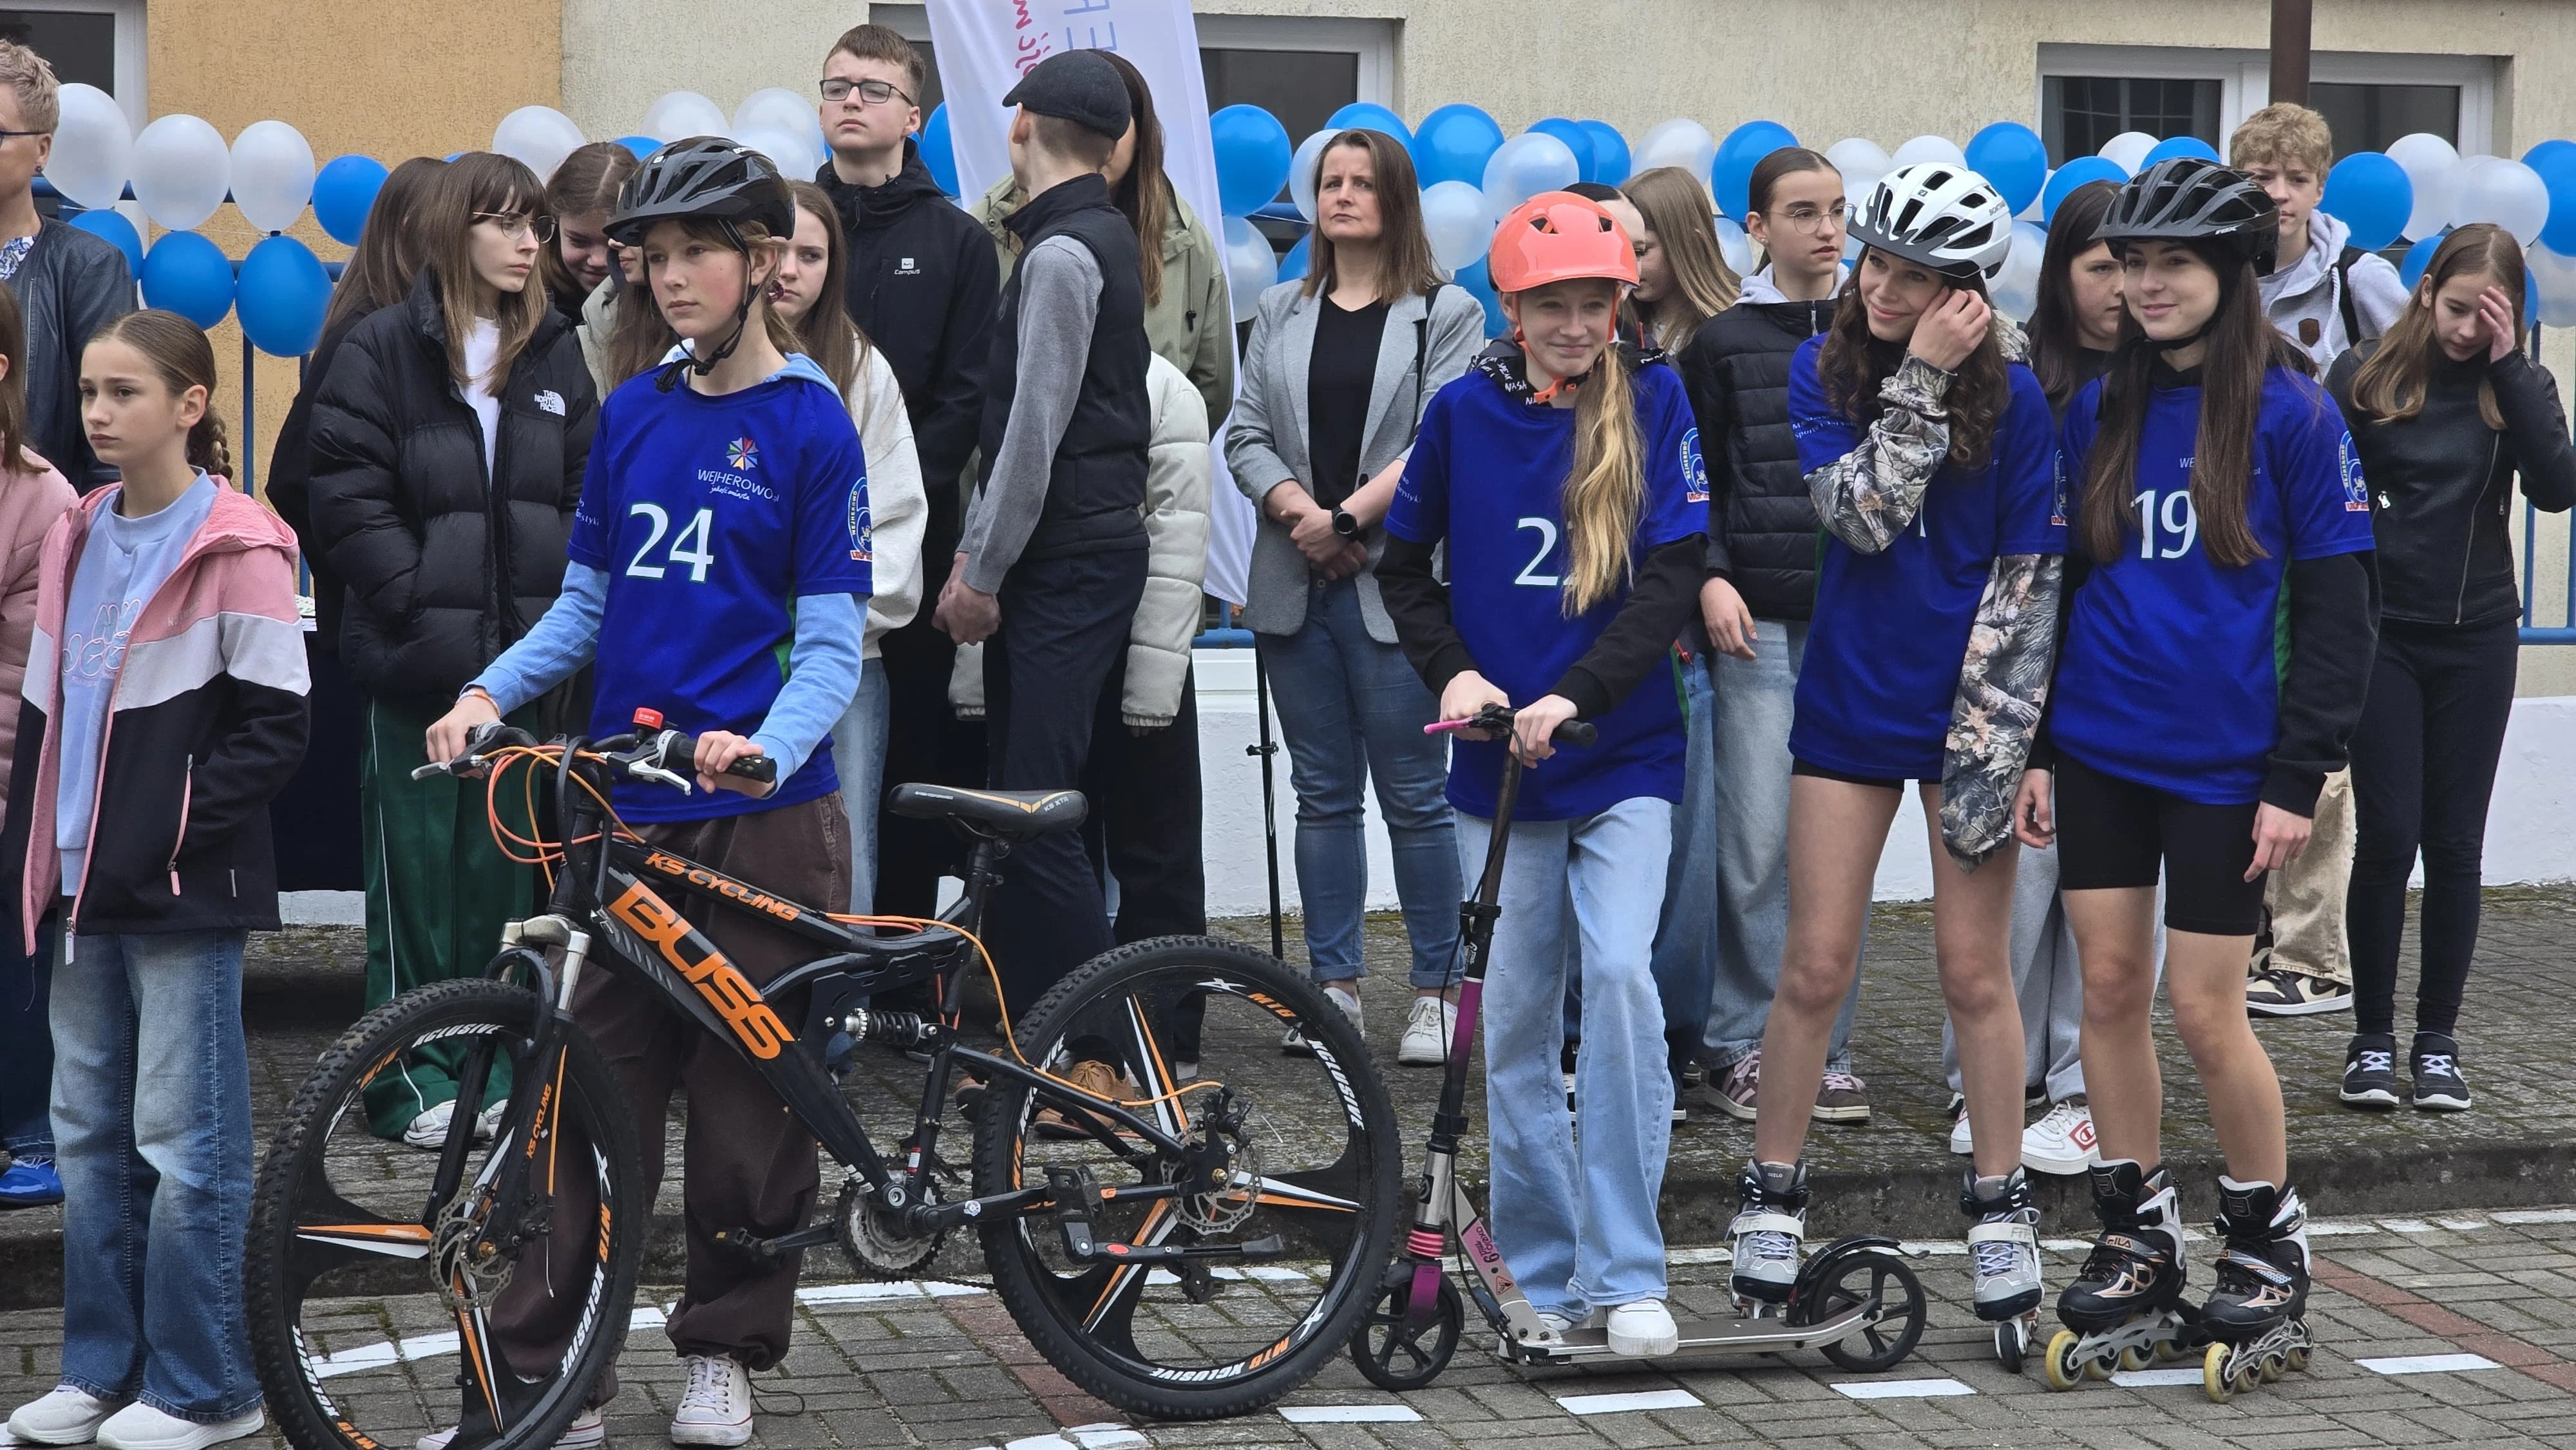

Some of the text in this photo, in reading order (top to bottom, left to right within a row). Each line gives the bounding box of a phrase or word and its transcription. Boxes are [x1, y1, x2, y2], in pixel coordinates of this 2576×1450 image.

[626, 504, 714, 582] 24
[1515, 517, 1575, 586] 2
[2130, 490, 2197, 559] 19
[645, 852, 800, 921] KS CYCLING
[608, 880, 795, 1059] BUSS
[411, 1023, 505, 1049] XCLUSIVE
[533, 1082, 552, 1140] CYCLING
[1307, 1039, 1365, 1131] XCLUSIVE
[1476, 1226, 1493, 1251] oxelo
[562, 1262, 605, 1379] XCLUSIVE
[292, 1324, 341, 1417] XCLUSIVE
[1149, 1361, 1246, 1382] XCLUSIVE
